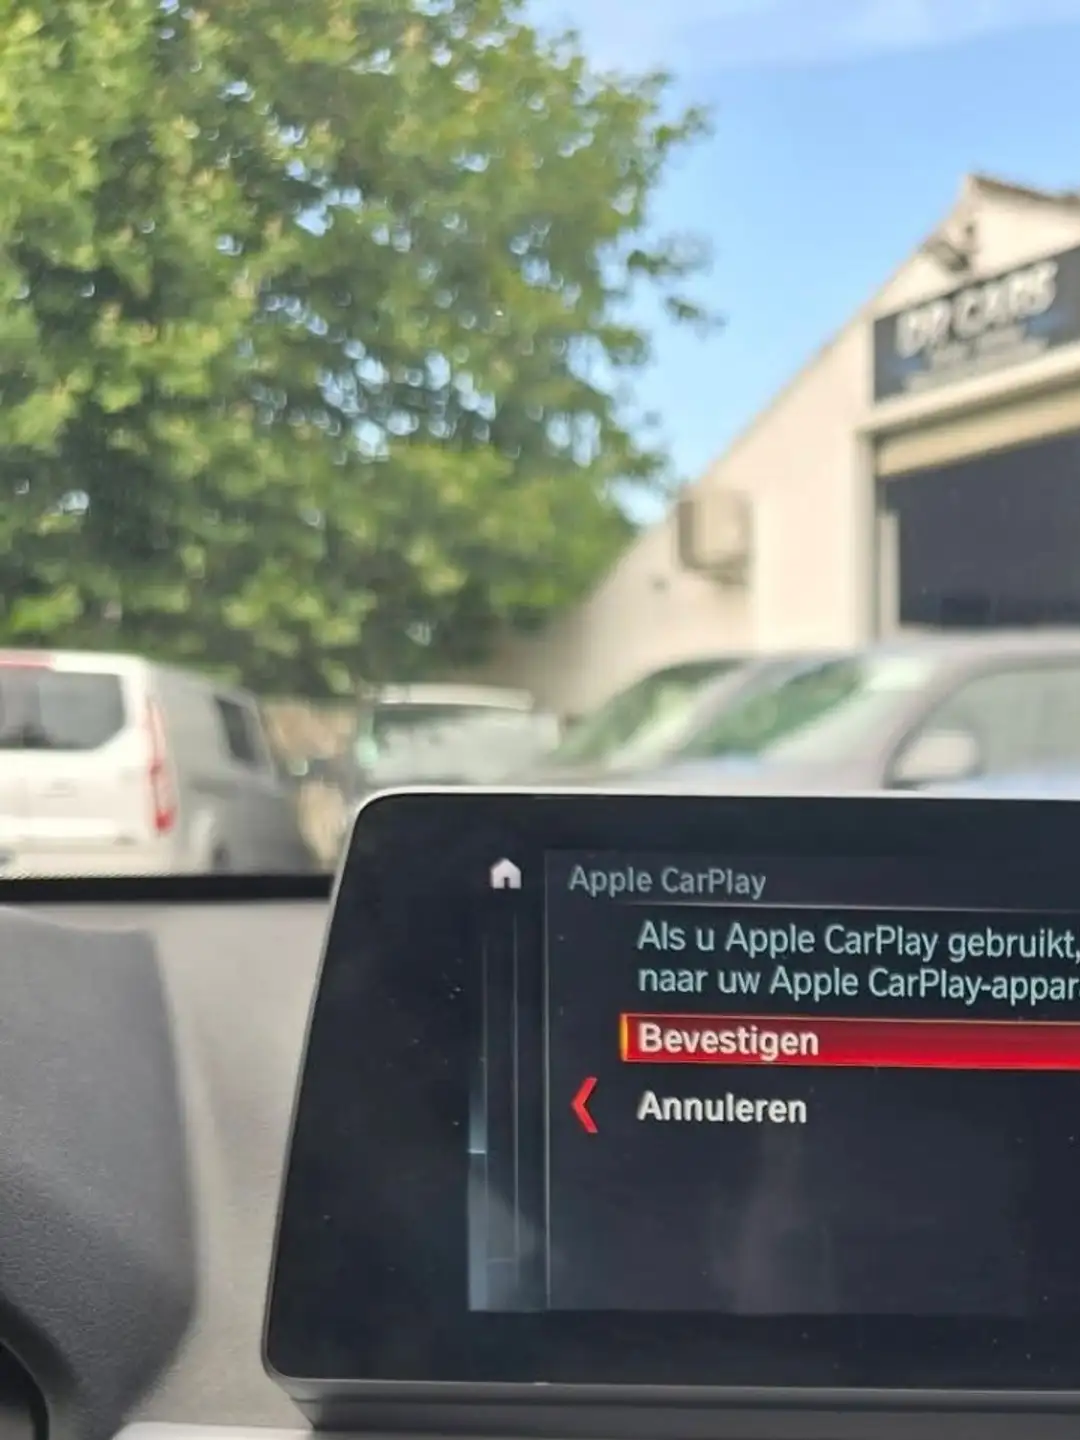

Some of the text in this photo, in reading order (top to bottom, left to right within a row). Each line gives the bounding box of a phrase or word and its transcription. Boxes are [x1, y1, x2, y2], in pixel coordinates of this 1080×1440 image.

[569, 865, 766, 900] Apple CarPlay
[637, 920, 686, 952] Als
[695, 930, 715, 953] u
[725, 922, 815, 959] Apple
[824, 924, 938, 962] CarPlay
[638, 972, 707, 995] naar
[717, 973, 760, 995] uw
[770, 965, 859, 1001] Apple
[638, 1022, 819, 1062] Bevestigen
[637, 1090, 808, 1124] Annuleren
